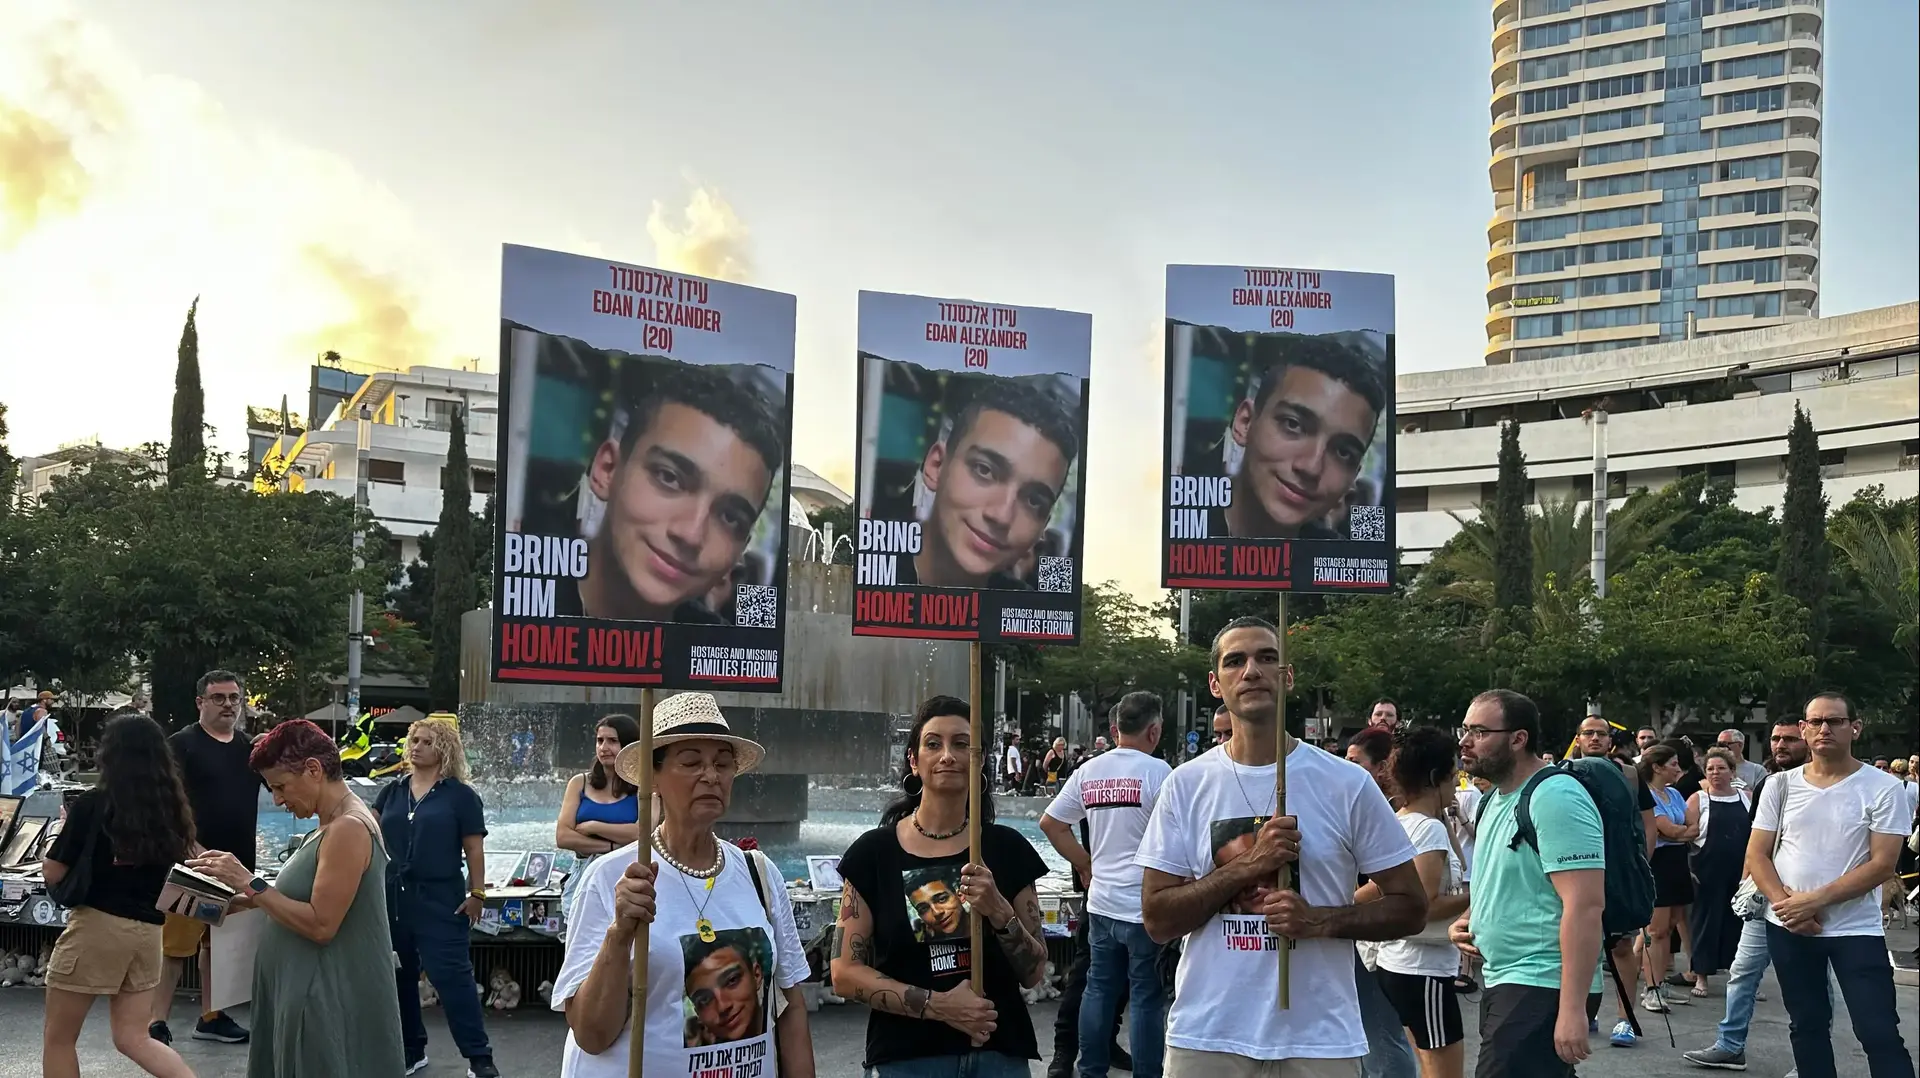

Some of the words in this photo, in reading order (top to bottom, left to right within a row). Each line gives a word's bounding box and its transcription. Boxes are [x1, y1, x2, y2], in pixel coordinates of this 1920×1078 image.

[609, 265, 673, 298] אלכסנדר
[1244, 269, 1293, 288] אלכסנדר
[1296, 271, 1320, 289] עידן
[677, 277, 708, 304] עידן
[1232, 288, 1263, 306] EDAN
[1266, 290, 1331, 310] ALEXANDER
[593, 290, 633, 318] EDAN
[636, 297, 721, 333] ALEXANDER
[938, 302, 988, 325] אלכסנדר
[992, 307, 1017, 327] עידן
[1270, 308, 1294, 329] (20)
[642, 326, 673, 353] (20)
[926, 323, 957, 344] EDAN
[960, 327, 1027, 350] ALEXANDER
[964, 348, 988, 370] (20)
[1170, 475, 1232, 507] BRING
[1169, 508, 1208, 539] HIM
[858, 519, 922, 553] BRING
[503, 532, 588, 578] BRING
[1168, 543, 1226, 575] HOME
[1232, 542, 1291, 577] NOW!
[1313, 557, 1346, 568] HOSTAGES
[1346, 557, 1360, 568] AND
[1360, 558, 1388, 569] MISSING
[857, 553, 897, 586] HIM
[1313, 567, 1354, 583] FAMILIES
[1355, 568, 1388, 584] FORUM
[502, 576, 556, 618] HIM
[856, 590, 915, 624] HOME
[920, 592, 980, 627] NOW!
[1001, 607, 1033, 619] HOSTAGES
[1033, 609, 1046, 620] AND
[1046, 610, 1074, 621] MISSING
[1001, 618, 1041, 634] FAMILIES
[1041, 620, 1074, 636] FORUM
[502, 623, 580, 665] HOME
[587, 626, 663, 669] NOW!
[690, 645, 729, 660] HOSTAGES
[729, 647, 745, 661] AND
[746, 648, 778, 662] MISSING
[689, 658, 739, 677] FAMILIES
[740, 660, 777, 679] FORUM
[1104, 779, 1115, 789] AND
[1116, 778, 1143, 789] MISSING
[1081, 789, 1111, 805] FAMILIES
[1112, 788, 1141, 804] FORUM
[1222, 920, 1241, 936] עידן
[1243, 920, 1259, 935] את
[1226, 935, 1262, 951] עכשיו!
[930, 955, 957, 972] HOME
[688, 1051, 714, 1074] עידן
[716, 1048, 732, 1066] את
[734, 1040, 767, 1064] מחזירים
[736, 1059, 762, 1078] הביתה
